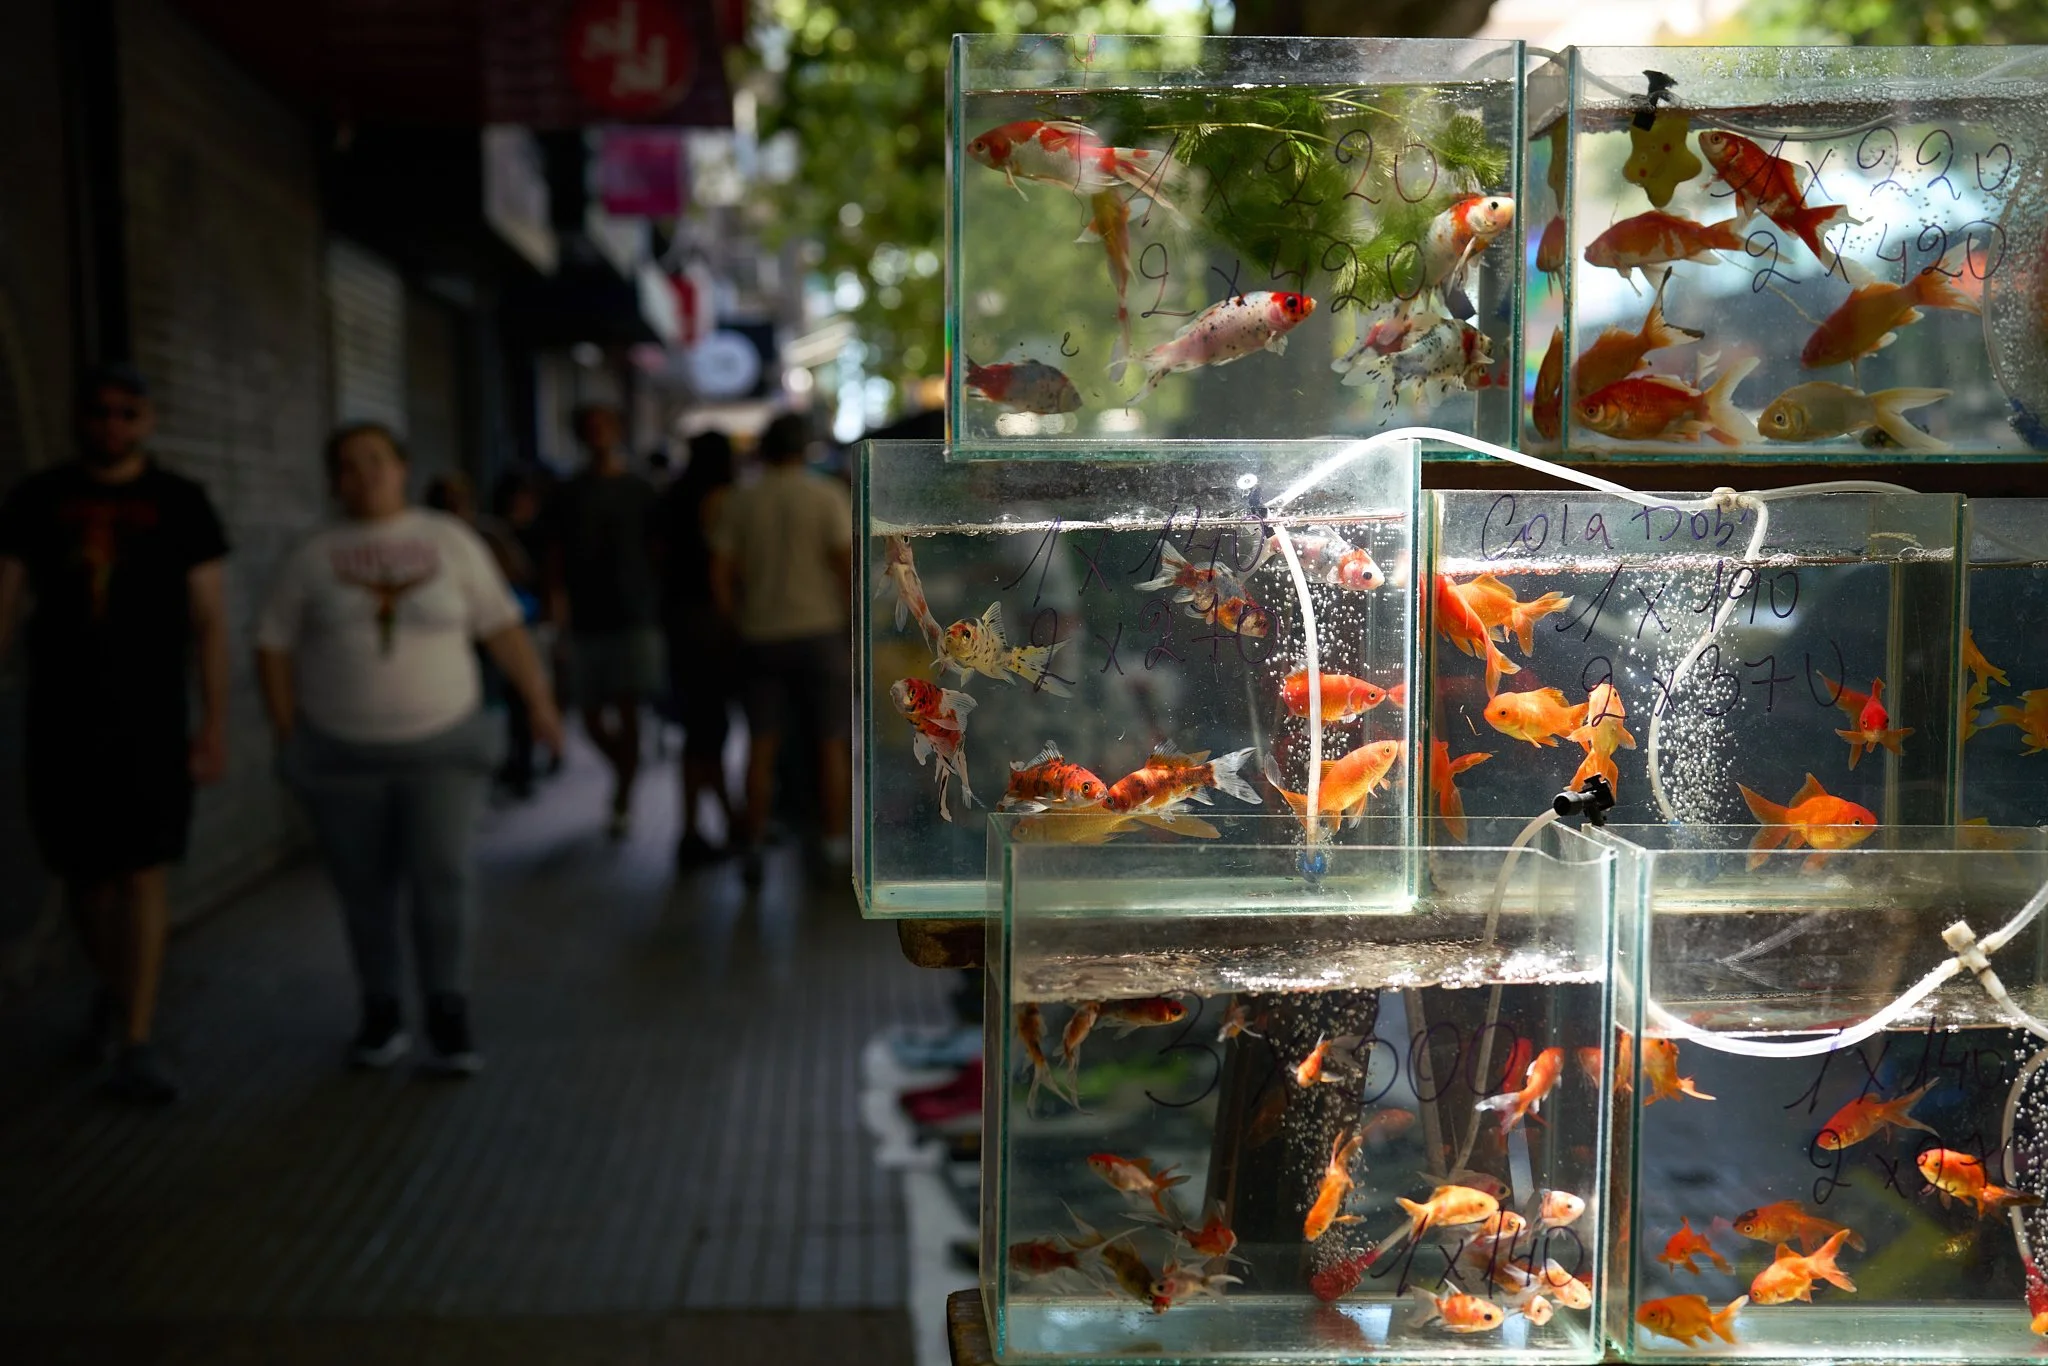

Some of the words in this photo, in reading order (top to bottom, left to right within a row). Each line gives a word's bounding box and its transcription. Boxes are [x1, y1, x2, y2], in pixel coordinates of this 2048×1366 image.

[1856, 125, 2013, 201] 220
[1139, 242, 1197, 319] 2
[1744, 230, 1802, 293] 2
[1876, 220, 2008, 284] 420
[1481, 493, 1614, 561] Cola
[1028, 606, 1077, 693] 2
[1581, 656, 1629, 728] 2
[1144, 989, 1223, 1108] 3
[1808, 1128, 1852, 1205] 2
